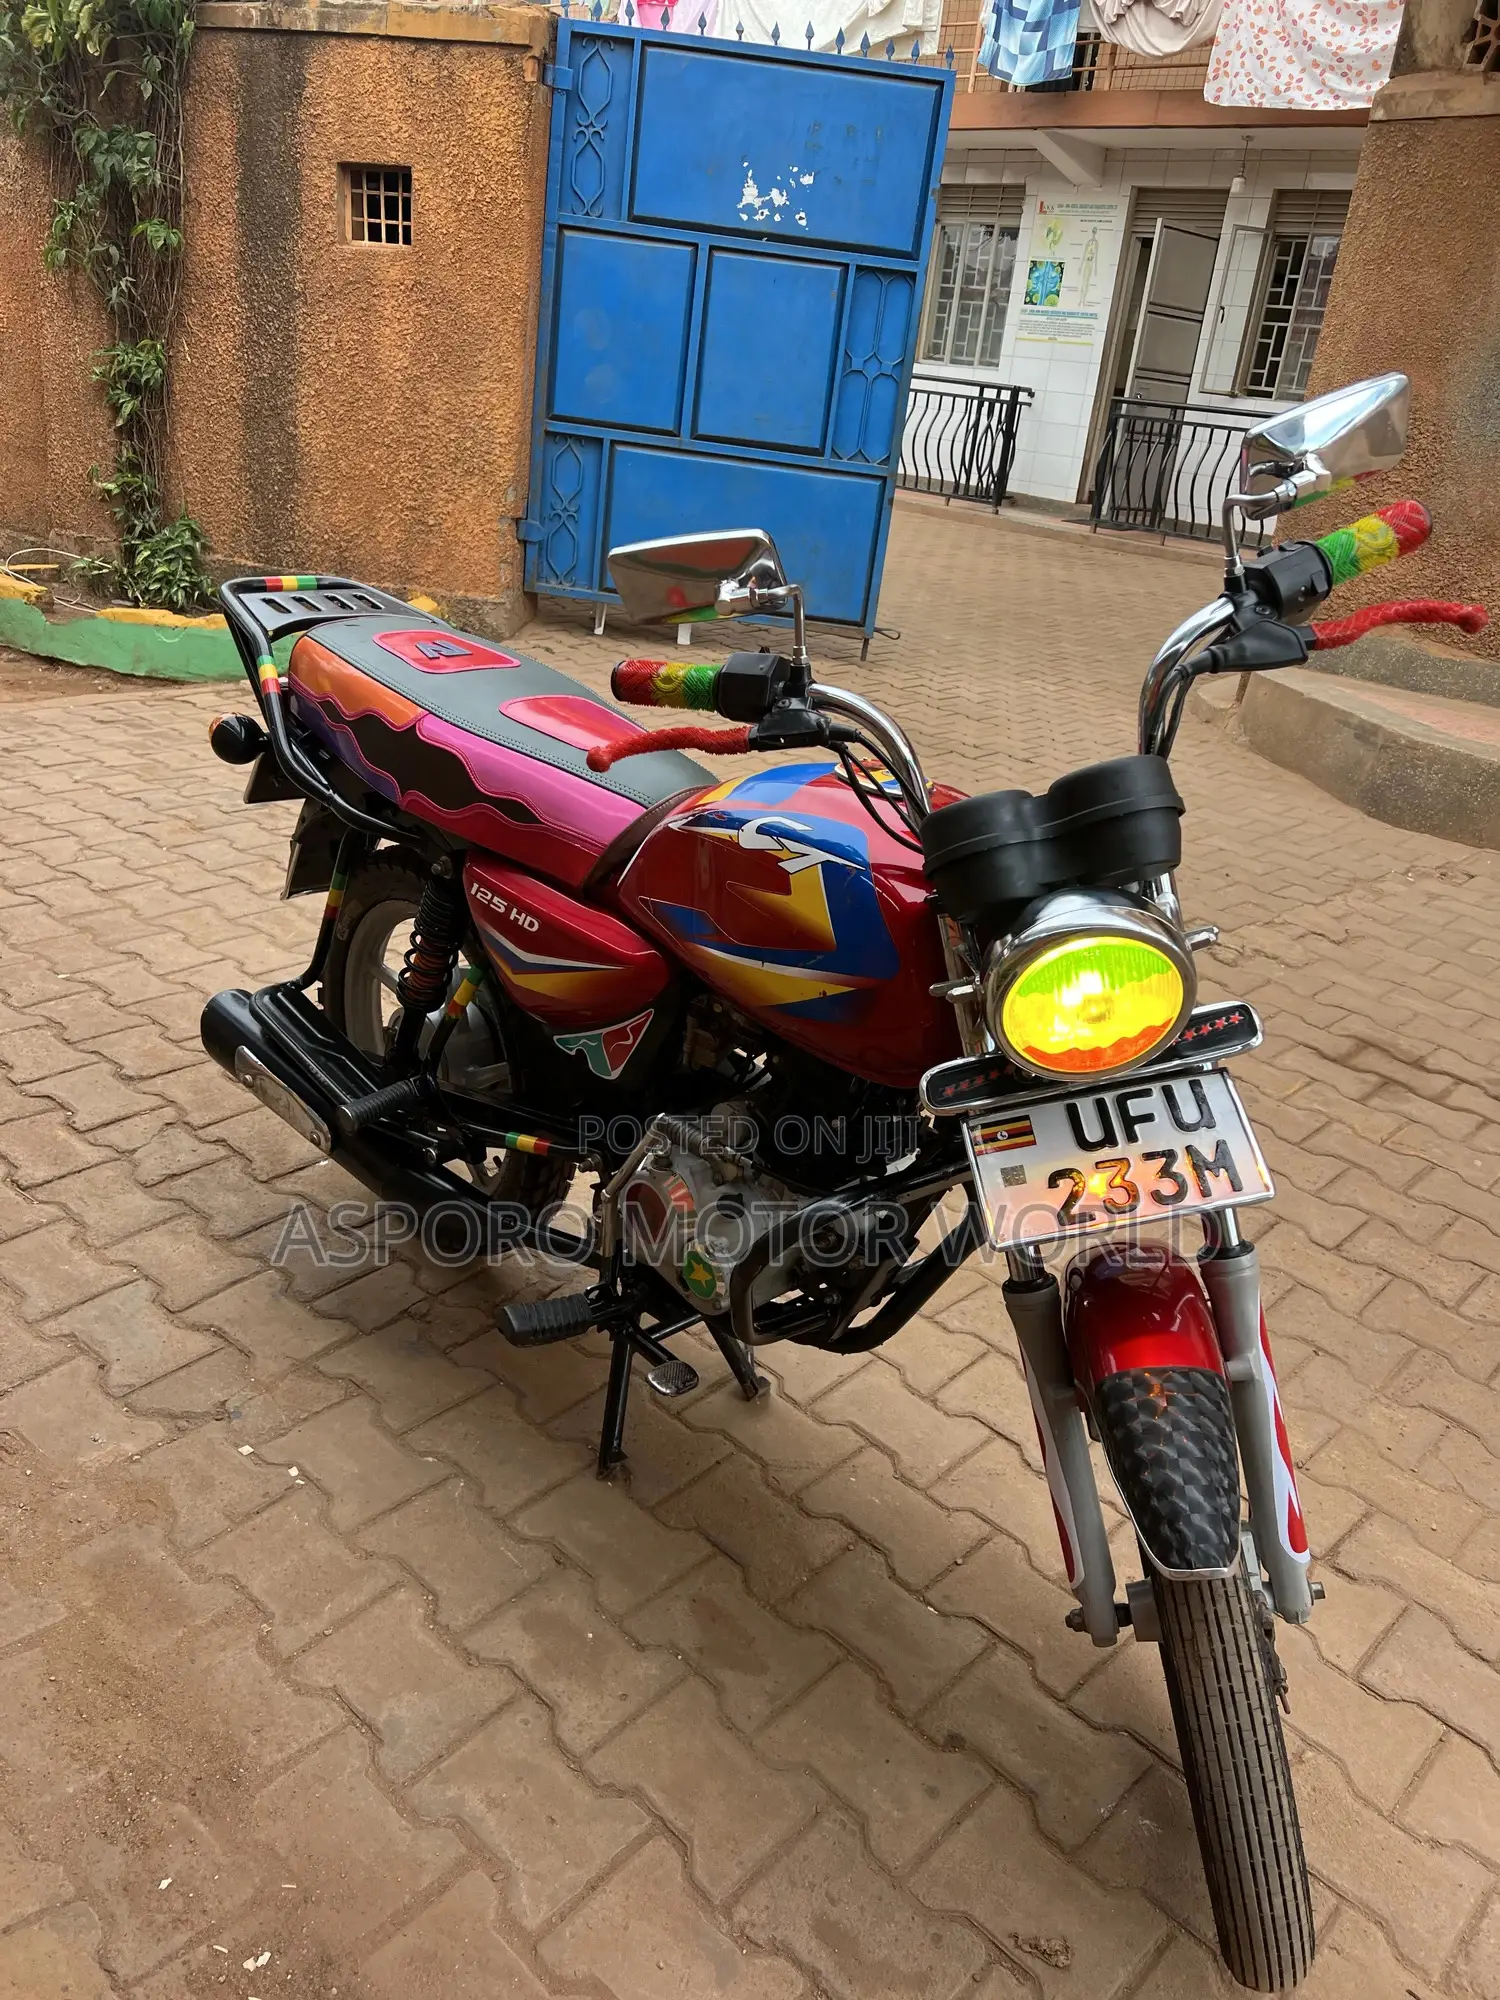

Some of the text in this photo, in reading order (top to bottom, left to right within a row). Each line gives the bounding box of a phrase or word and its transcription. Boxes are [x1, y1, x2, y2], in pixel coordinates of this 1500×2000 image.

[470, 882, 541, 933] 125 HD
[1065, 1079, 1217, 1152] UFU
[1047, 1139, 1244, 1227] 233M
